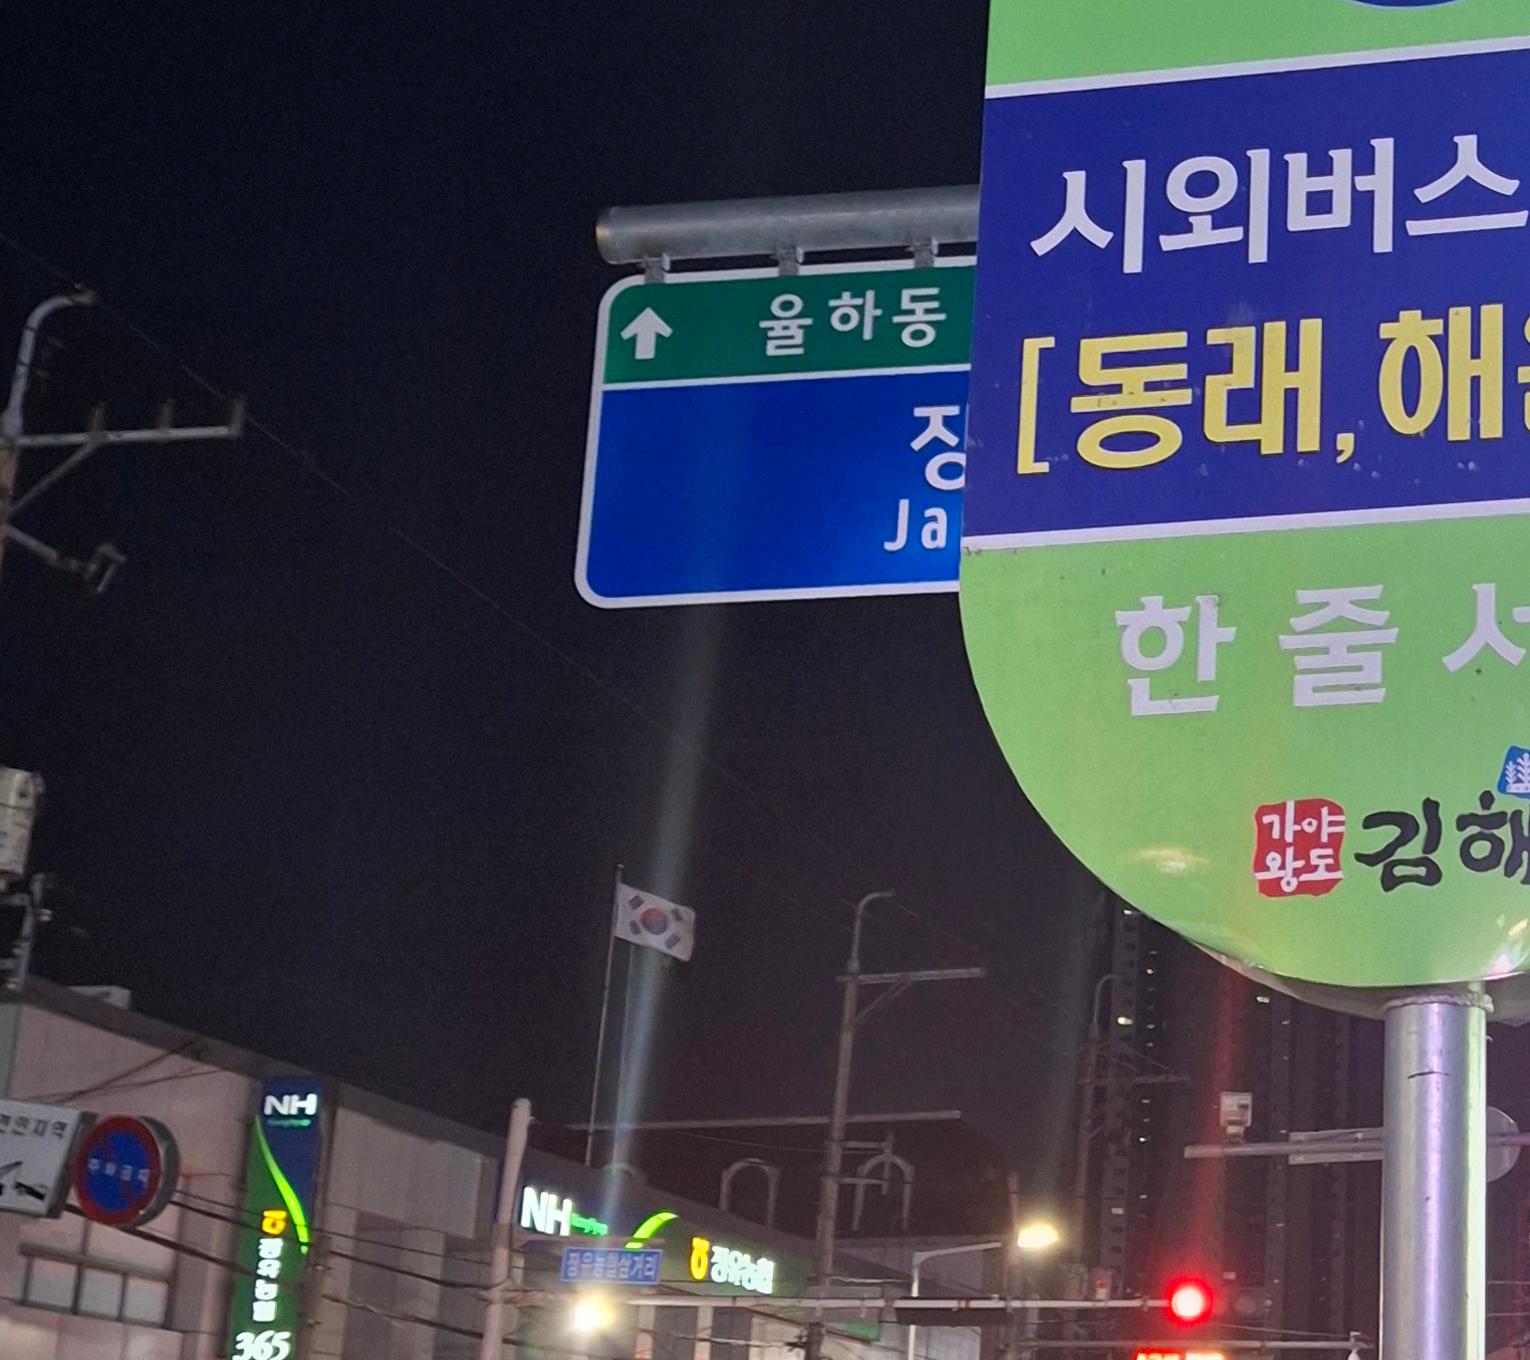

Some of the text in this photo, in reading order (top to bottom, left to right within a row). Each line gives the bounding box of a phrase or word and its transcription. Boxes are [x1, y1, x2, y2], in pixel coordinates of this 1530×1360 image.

[1030, 136, 1529, 273] 시외버스
[759, 287, 947, 356] 율하동
[883, 499, 948, 552] Ja
[1261, 801, 1344, 841] 가야
[1256, 843, 1343, 893] 왕도
[264, 1094, 317, 1116] NH
[521, 1187, 572, 1236] NH
